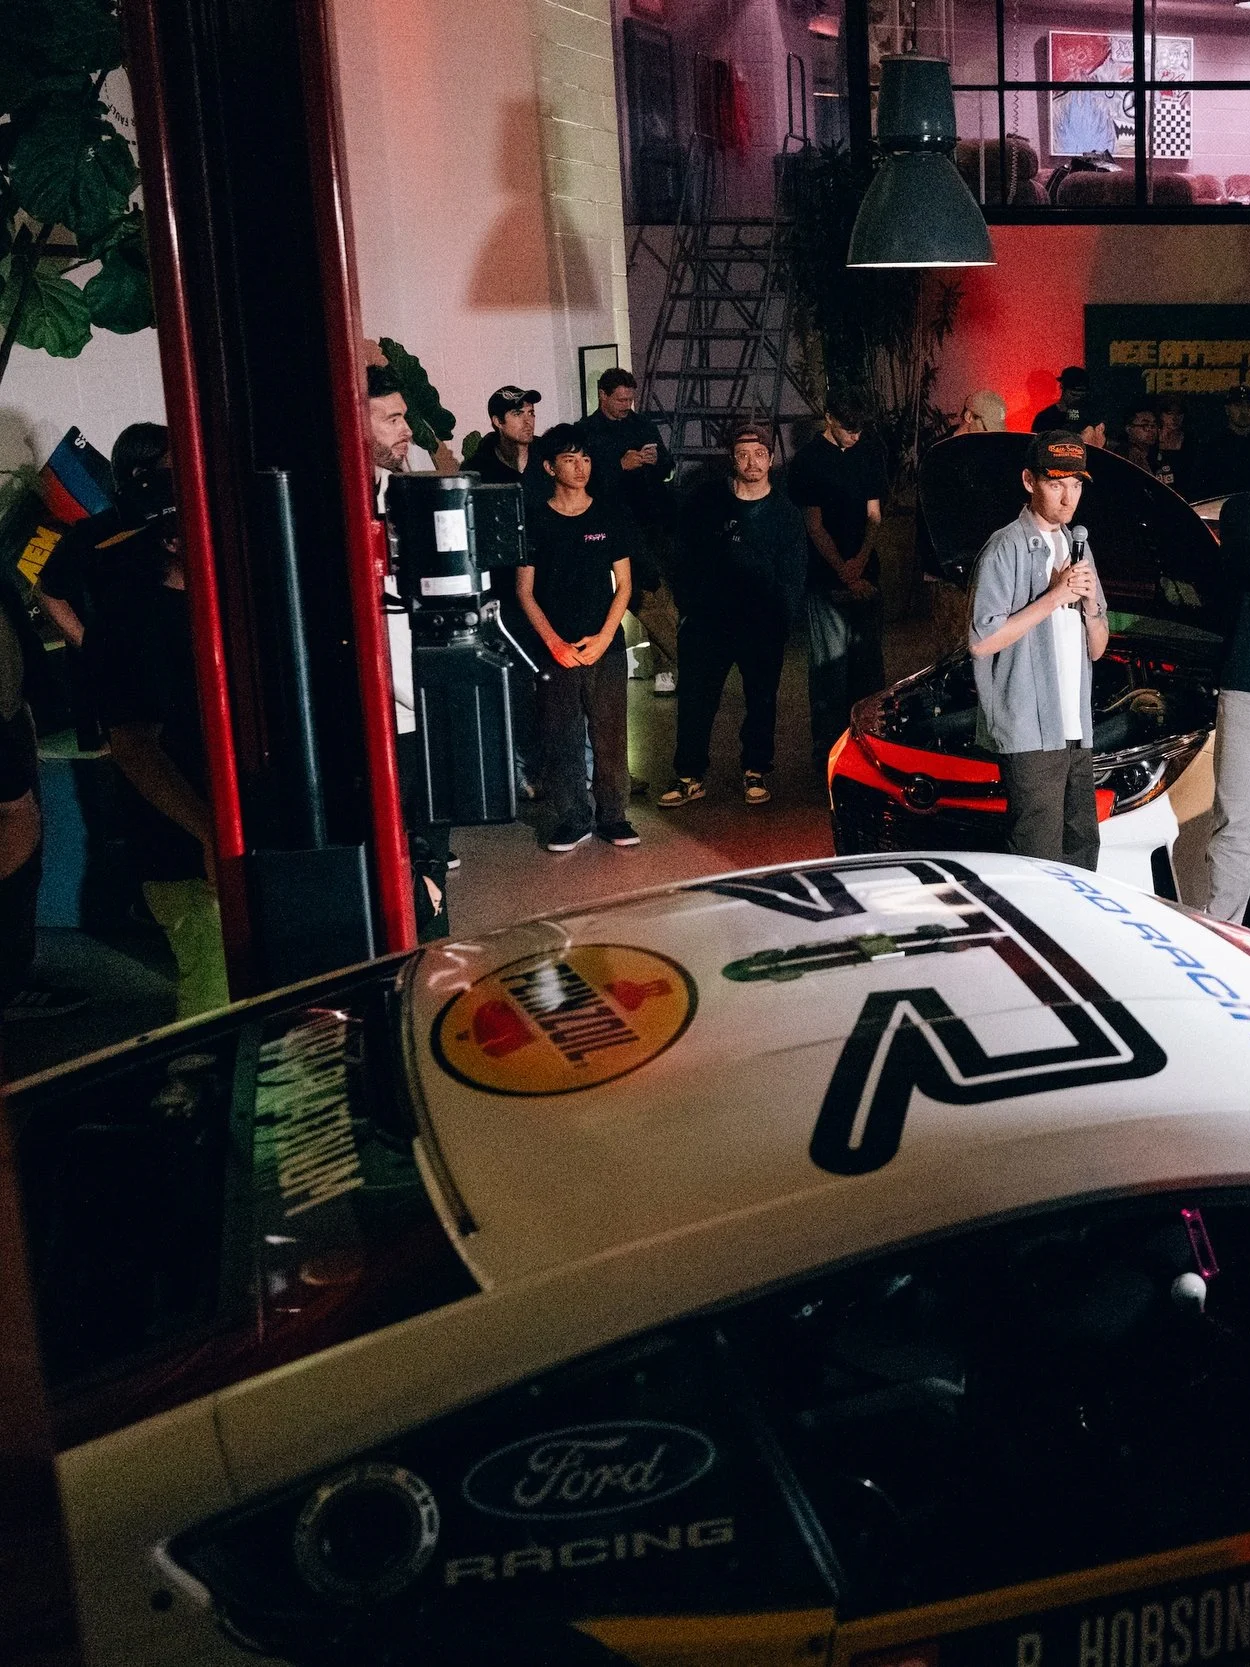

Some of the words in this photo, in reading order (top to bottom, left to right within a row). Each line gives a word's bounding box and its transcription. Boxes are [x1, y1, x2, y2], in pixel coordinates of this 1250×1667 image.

[1040, 864, 1131, 915] ORD
[512, 1435, 668, 1506] Ford
[444, 1516, 736, 1588] RACING
